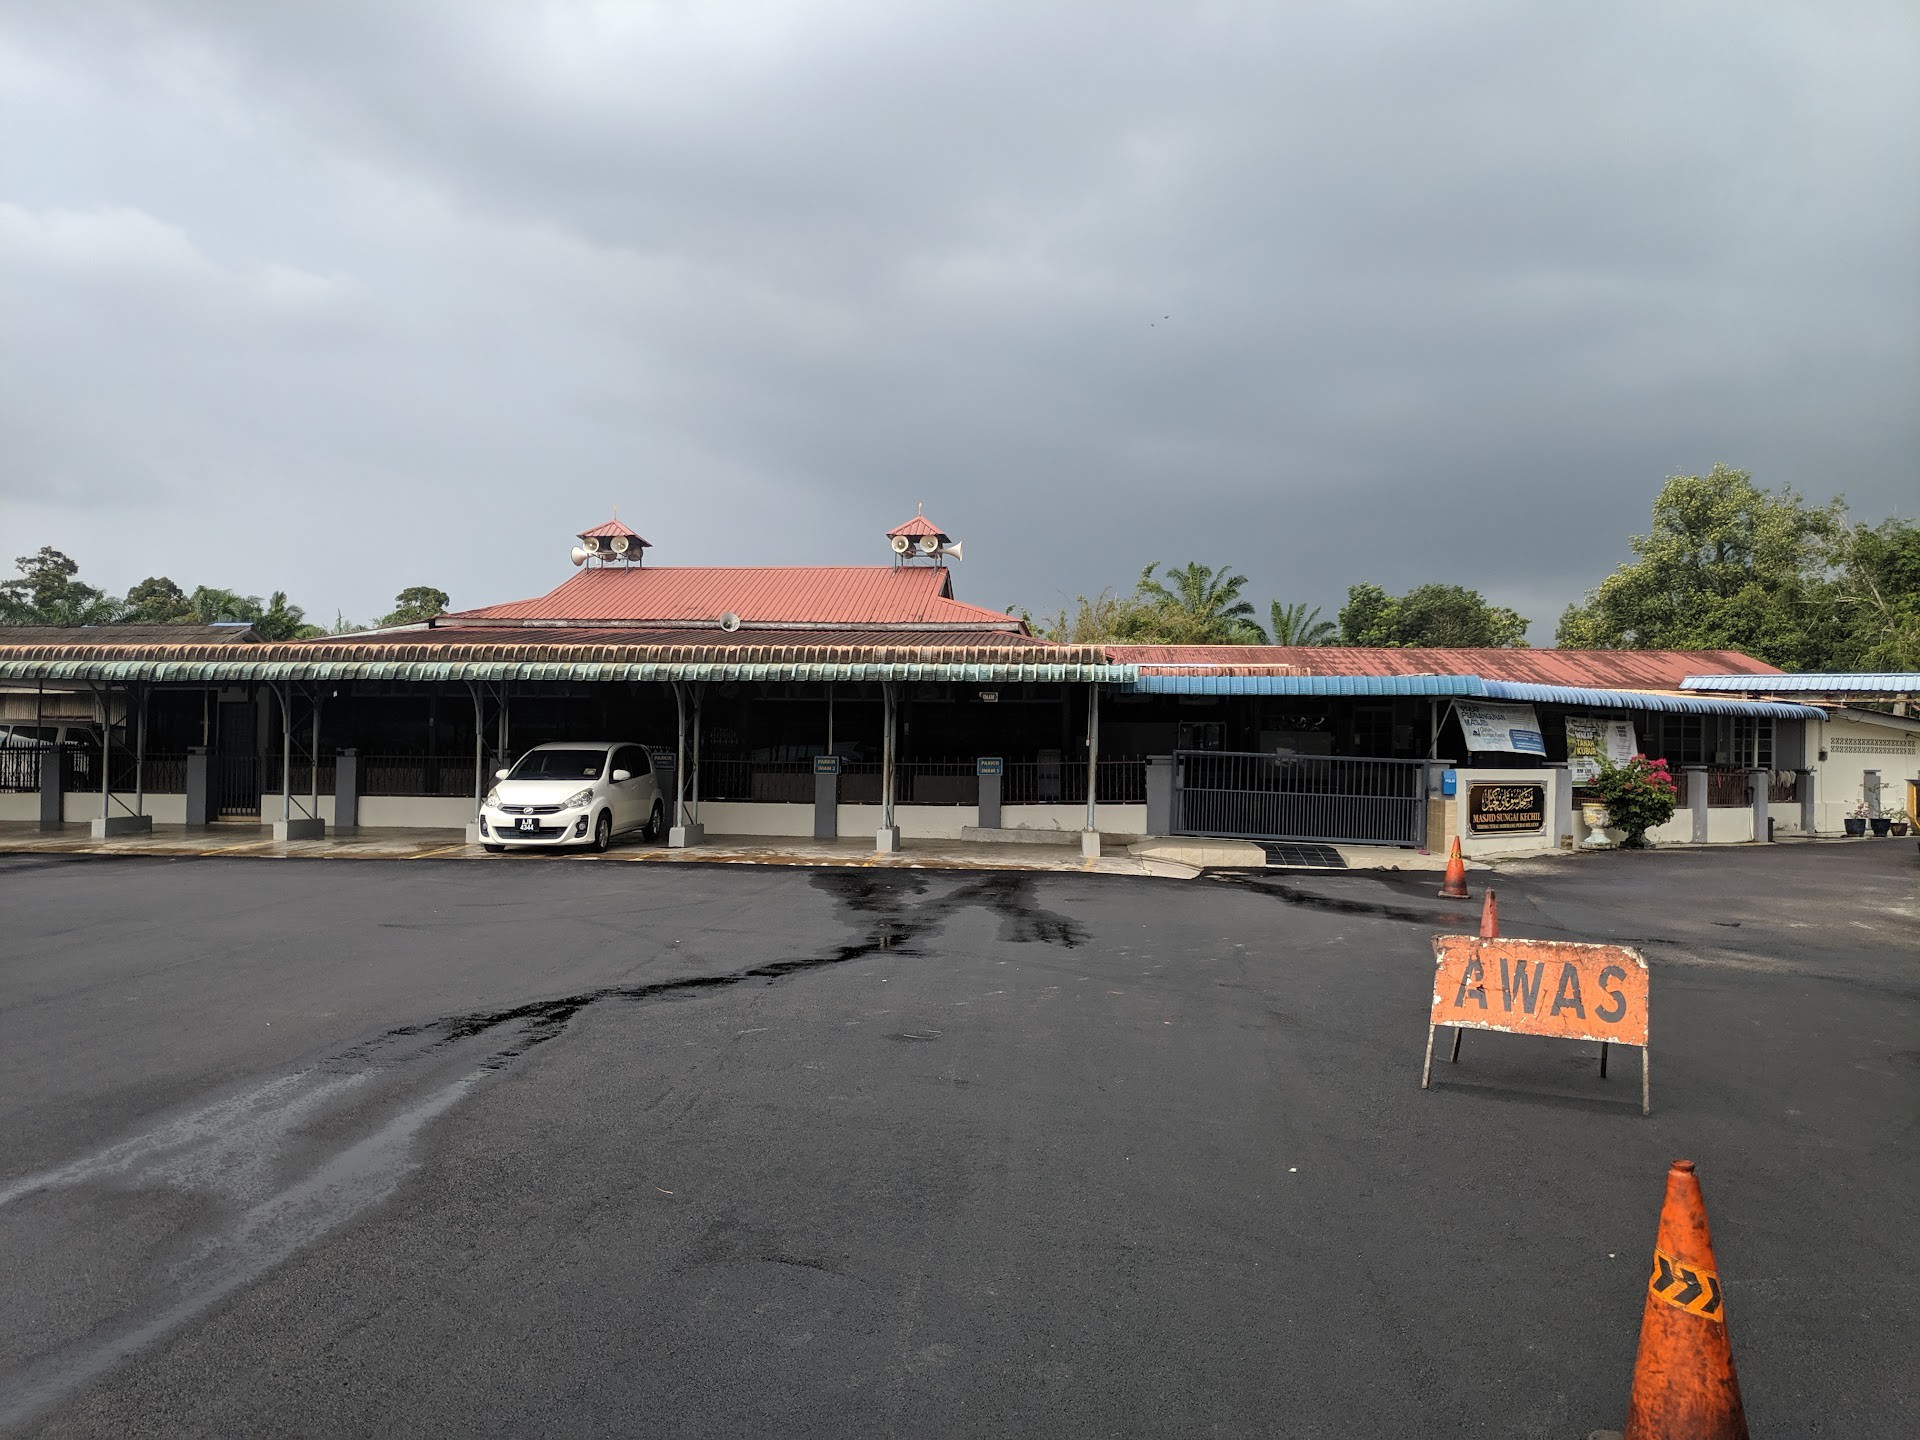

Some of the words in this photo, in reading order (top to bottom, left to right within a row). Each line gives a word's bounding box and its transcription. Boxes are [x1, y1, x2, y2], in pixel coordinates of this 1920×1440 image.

[1576, 739, 1595, 747] TANAH
[1576, 747, 1597, 755] KUBUR
[1473, 813, 1496, 823] MASJID
[1496, 812, 1519, 822] SUNGAI
[1519, 812, 1541, 821] KECHIL
[1453, 953, 1627, 1023] AWAS
